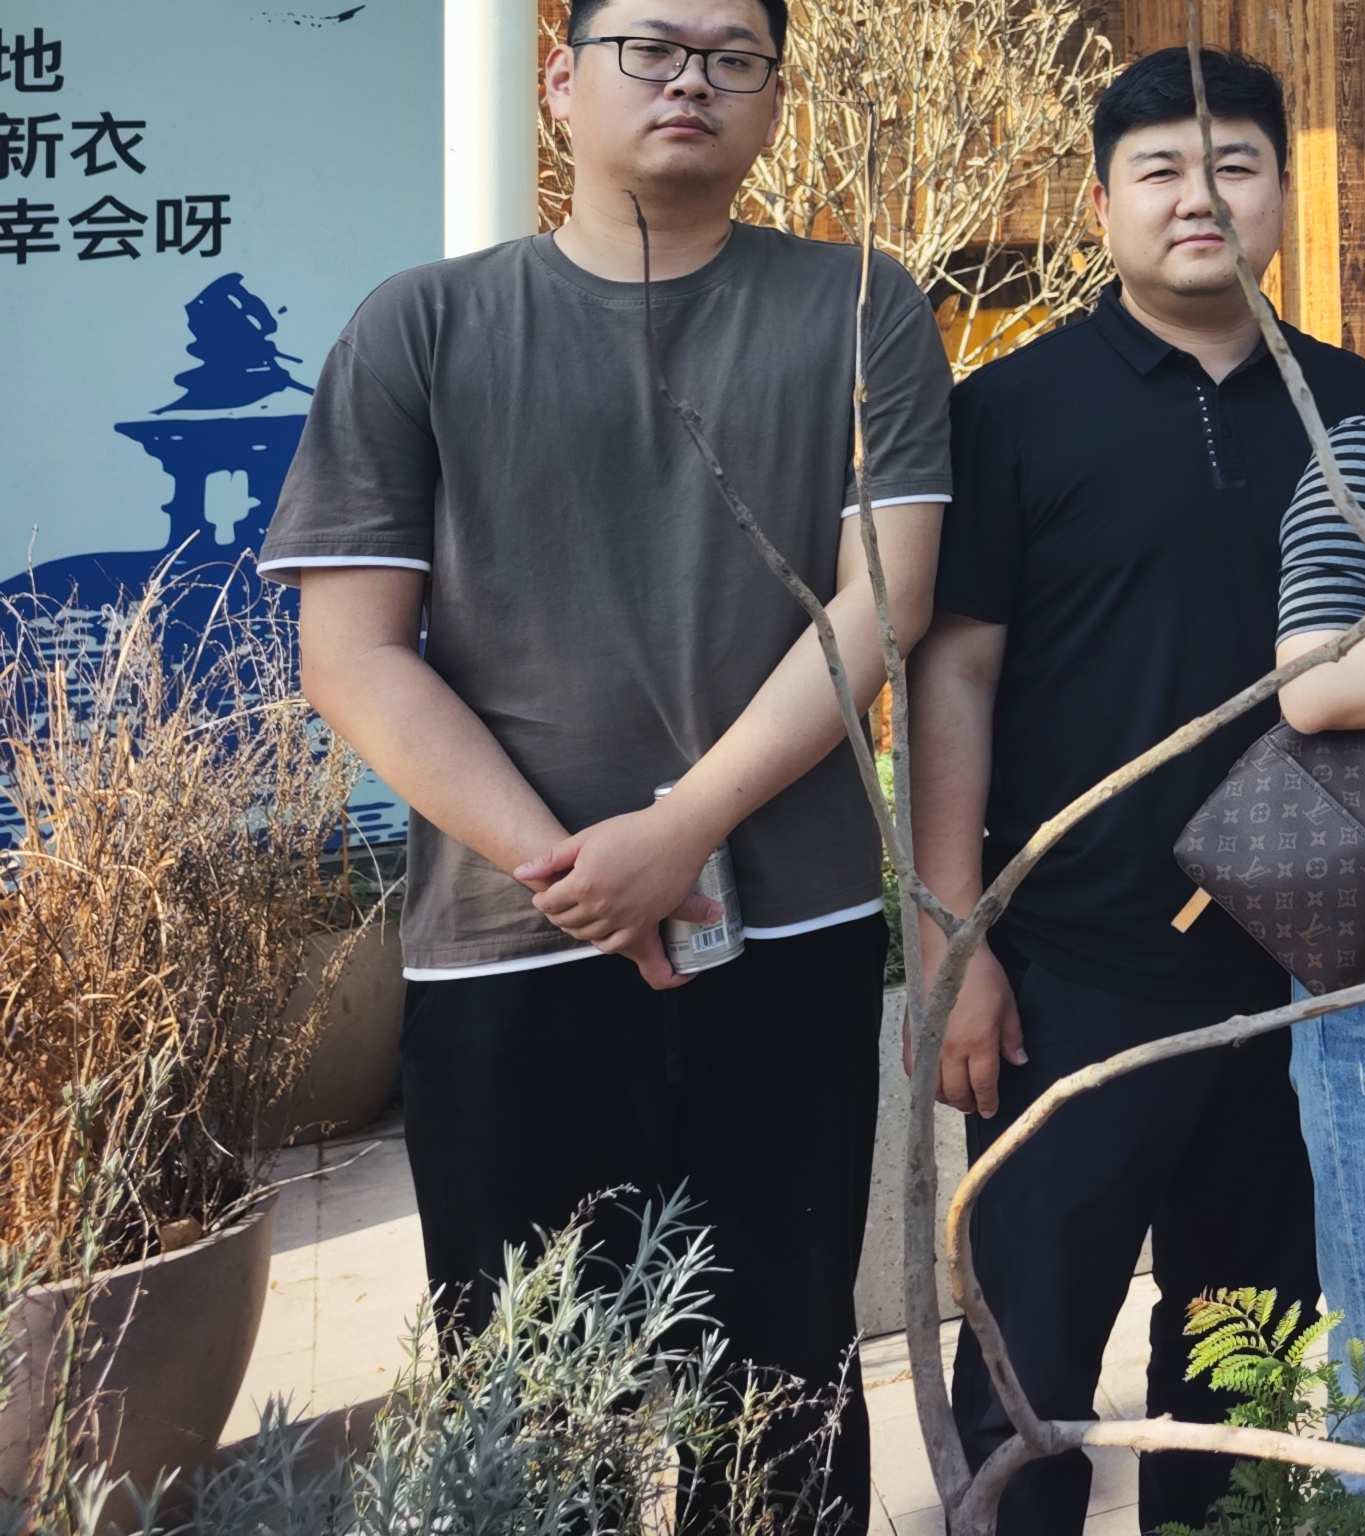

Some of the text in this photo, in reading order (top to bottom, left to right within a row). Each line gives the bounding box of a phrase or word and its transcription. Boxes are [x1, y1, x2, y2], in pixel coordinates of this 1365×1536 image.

[0, 27, 65, 94] 地
[0, 111, 147, 180] 新衣
[0, 194, 232, 265] 幸会呀
